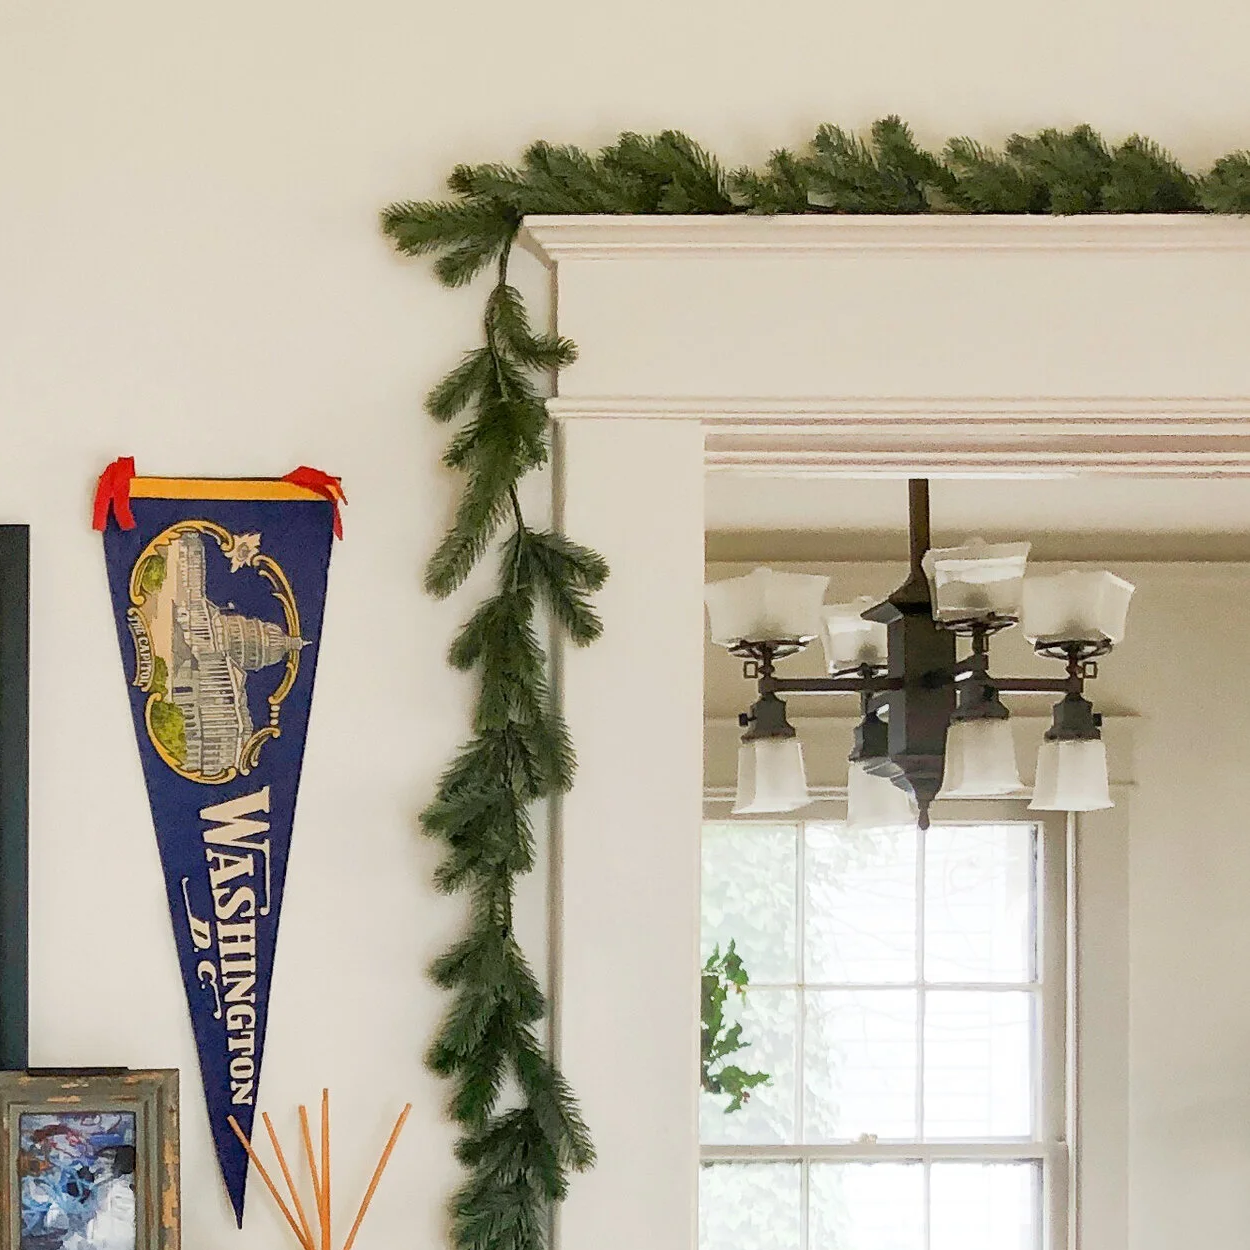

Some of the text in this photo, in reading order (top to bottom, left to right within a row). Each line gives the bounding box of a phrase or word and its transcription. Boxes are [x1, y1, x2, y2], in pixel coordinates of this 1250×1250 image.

[128, 615, 152, 686] THE CAPITOL
[199, 786, 270, 1105] WASHINGTON
